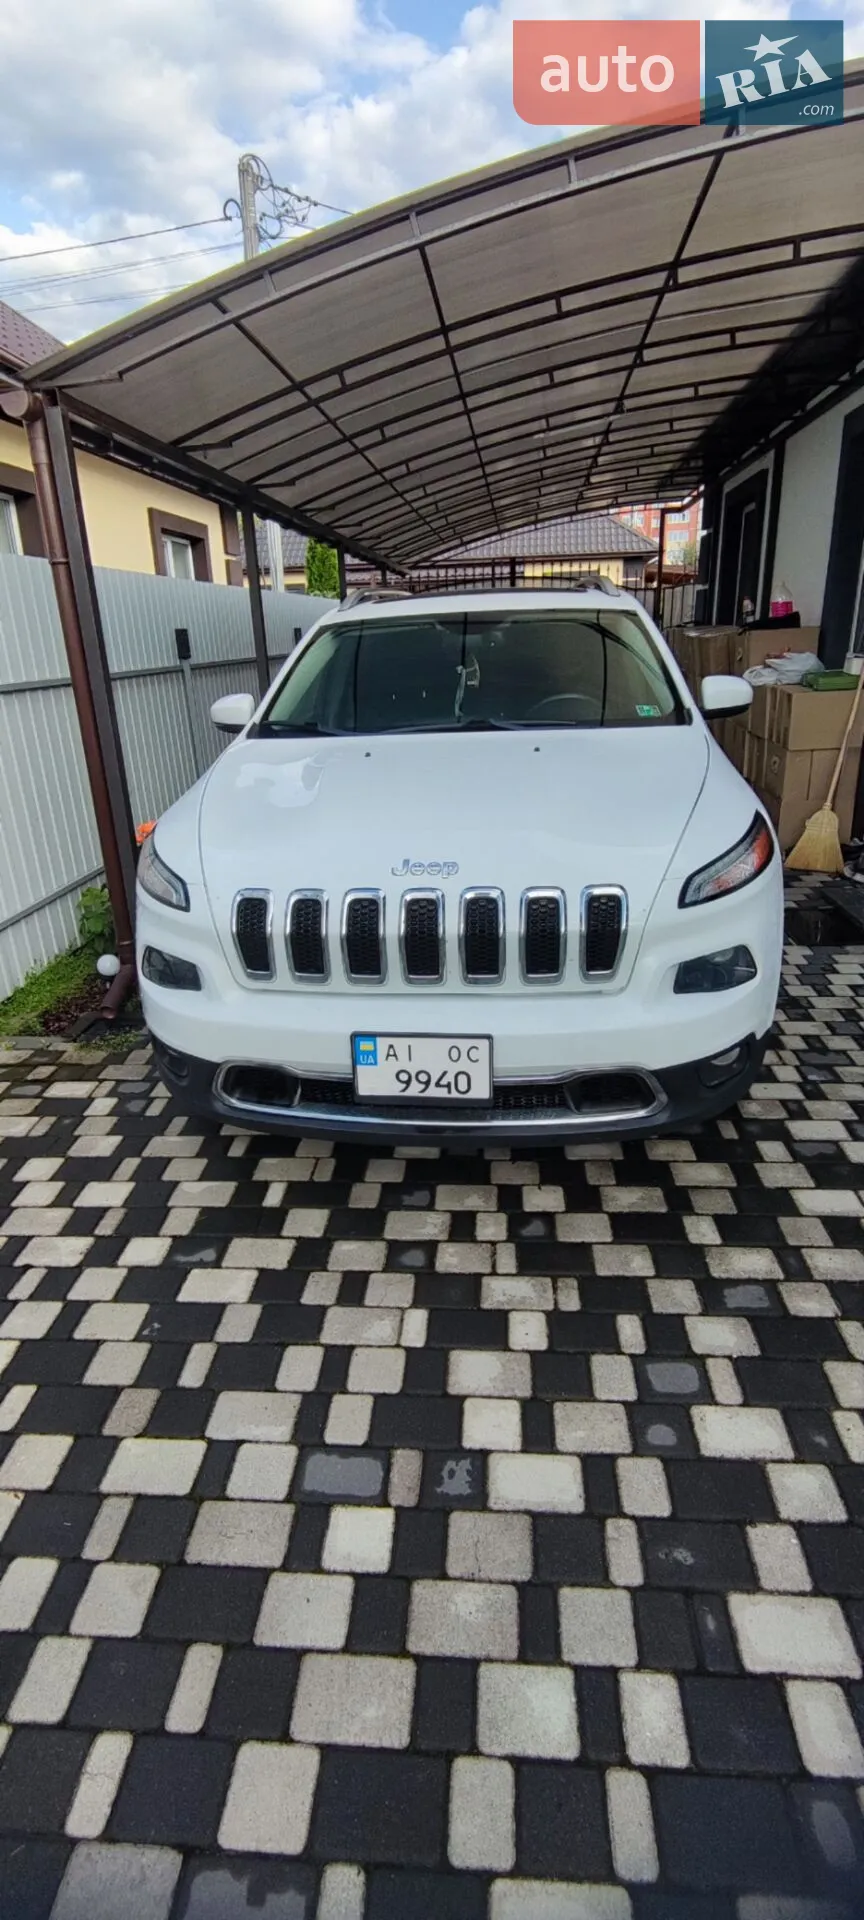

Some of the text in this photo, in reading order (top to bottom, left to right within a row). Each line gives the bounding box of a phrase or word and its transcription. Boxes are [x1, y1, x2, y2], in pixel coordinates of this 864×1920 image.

[391, 858, 459, 879] Jeep
[360, 1055, 375, 1064] UA
[395, 1069, 472, 1095] 9940
